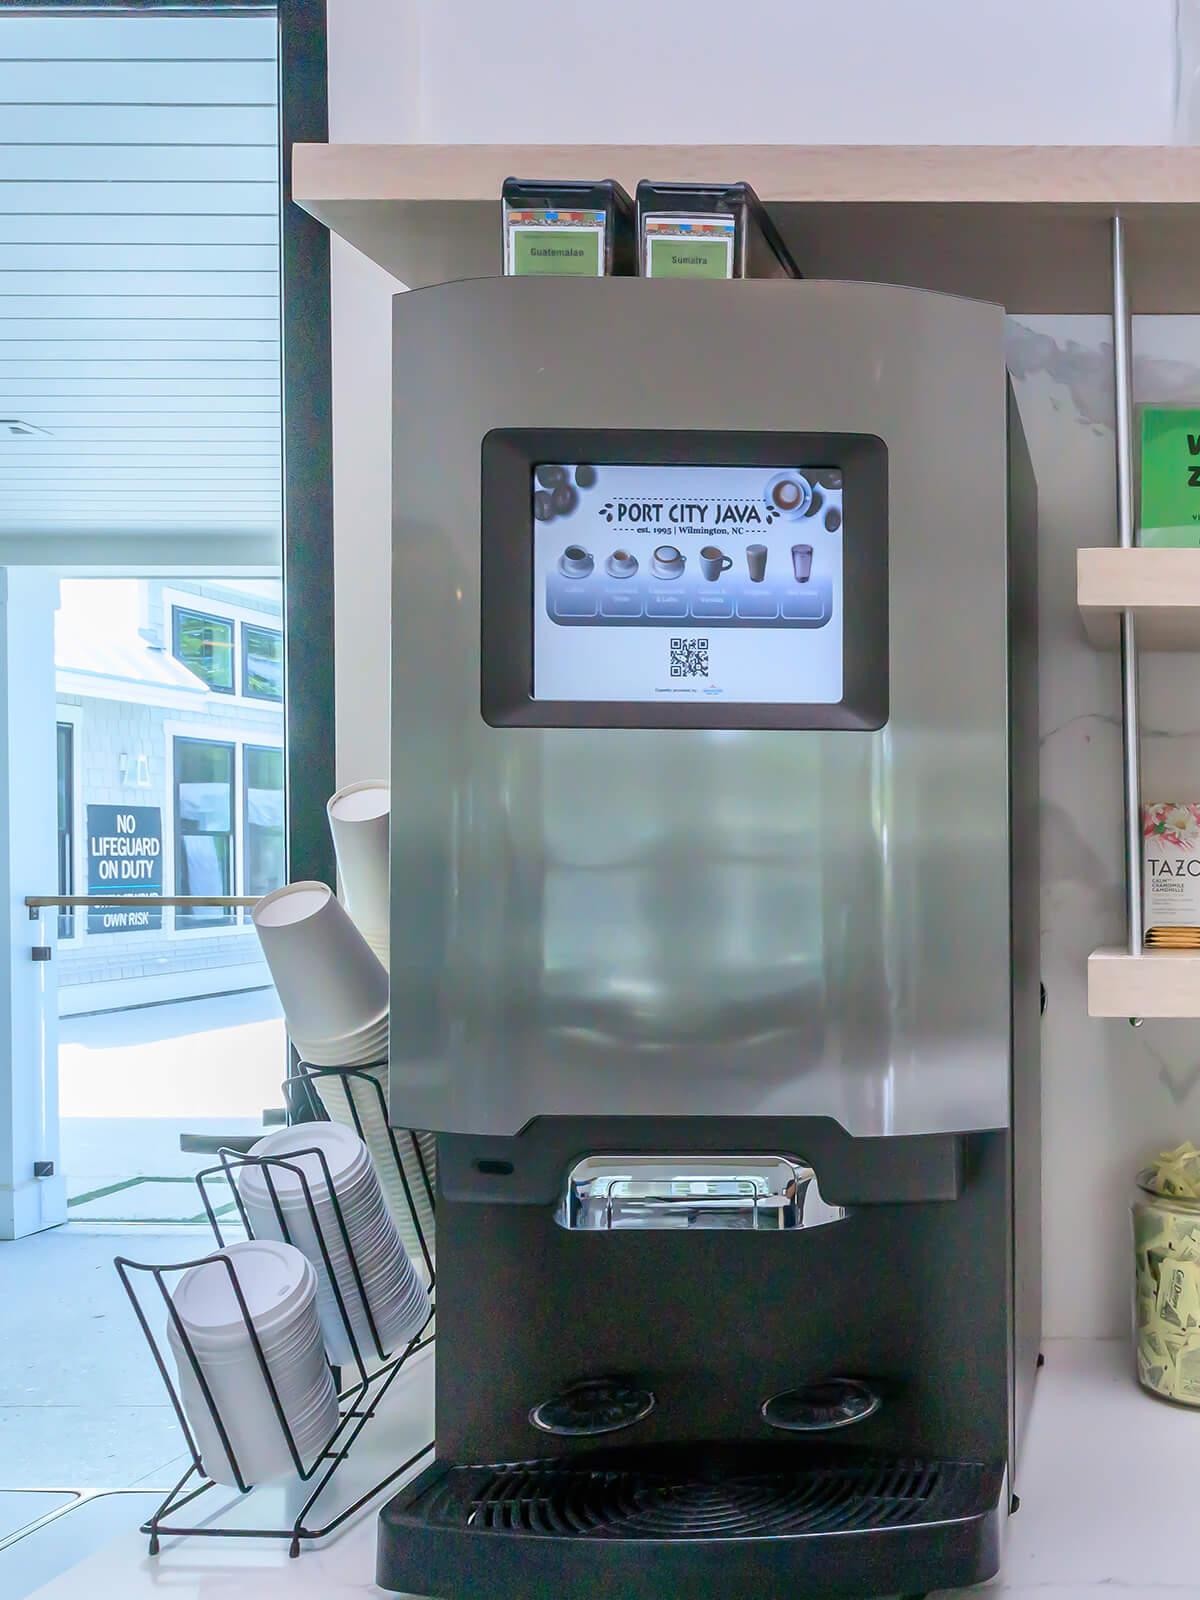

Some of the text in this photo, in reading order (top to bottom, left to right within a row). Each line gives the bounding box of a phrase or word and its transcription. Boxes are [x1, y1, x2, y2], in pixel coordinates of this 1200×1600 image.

[530, 247, 584, 257] Guatemalan
[672, 256, 708, 265] Sumatra
[617, 503, 762, 525] PORT CITY JAVA
[653, 527, 672, 535] 1995
[679, 526, 730, 536] Wilmington,
[732, 527, 744, 535] NC
[116, 814, 136, 833] NO
[92, 836, 160, 856] LIFEGUARD
[99, 859, 154, 879] ON DUTY
[104, 912, 149, 928] OWN RISK
